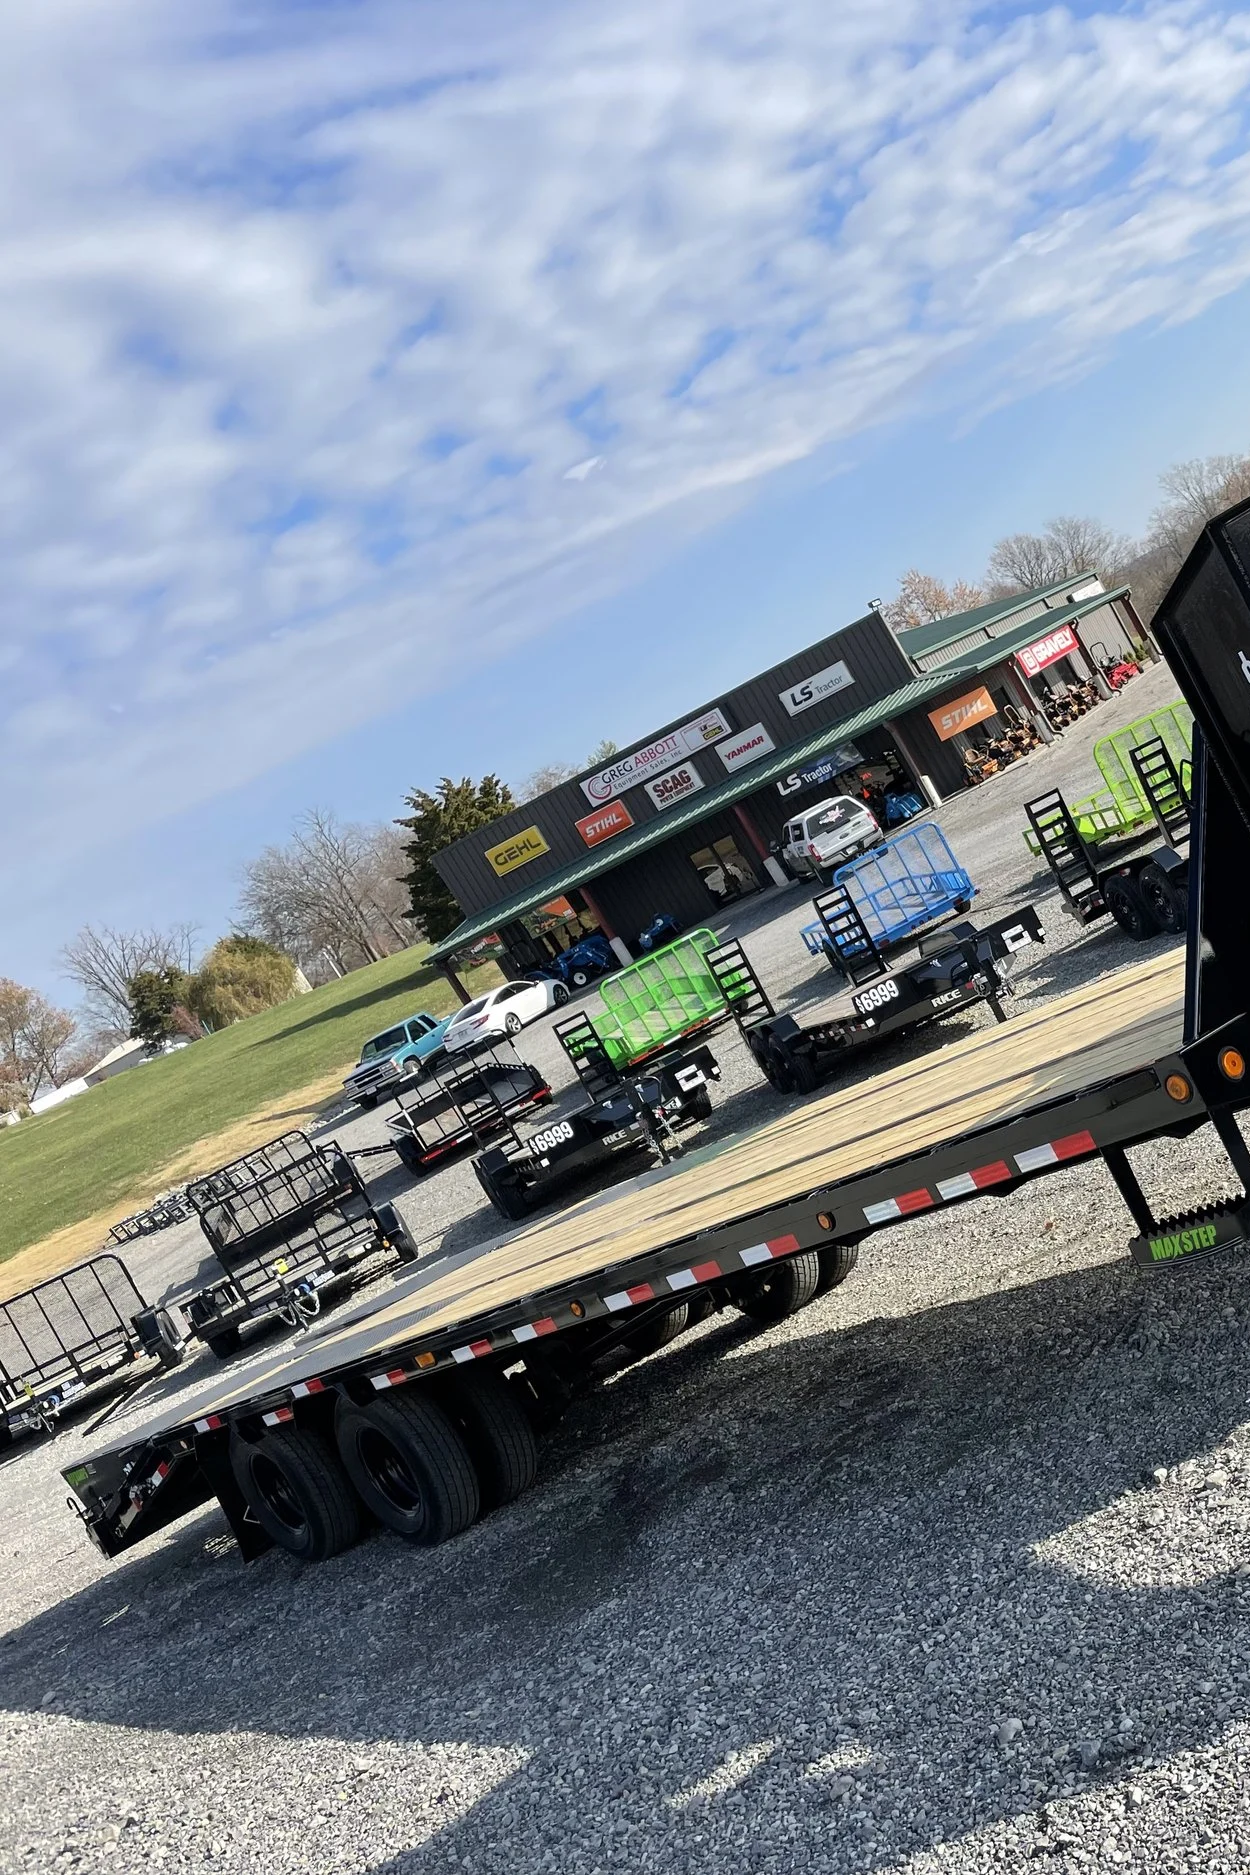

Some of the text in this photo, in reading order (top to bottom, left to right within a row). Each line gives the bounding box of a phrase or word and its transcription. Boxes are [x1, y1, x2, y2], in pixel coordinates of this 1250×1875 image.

[1032, 628, 1075, 664] GRAVELY
[790, 675, 843, 707] LS Tractor
[940, 697, 989, 731] STIHL
[602, 762, 632, 784] GREG
[634, 735, 678, 768] ABBOTT
[724, 735, 764, 760] YANMAR
[614, 767, 649, 790] Equipment
[650, 756, 670, 771] Sales,
[652, 769, 692, 798] SCAG
[776, 762, 834, 797] LS Tractor
[585, 813, 622, 838] STIHL
[494, 838, 541, 866] GEHL
[855, 979, 900, 1014] $6999
[931, 988, 962, 1007] RICE
[530, 1121, 574, 1155] $6999
[602, 1129, 628, 1146] RICE
